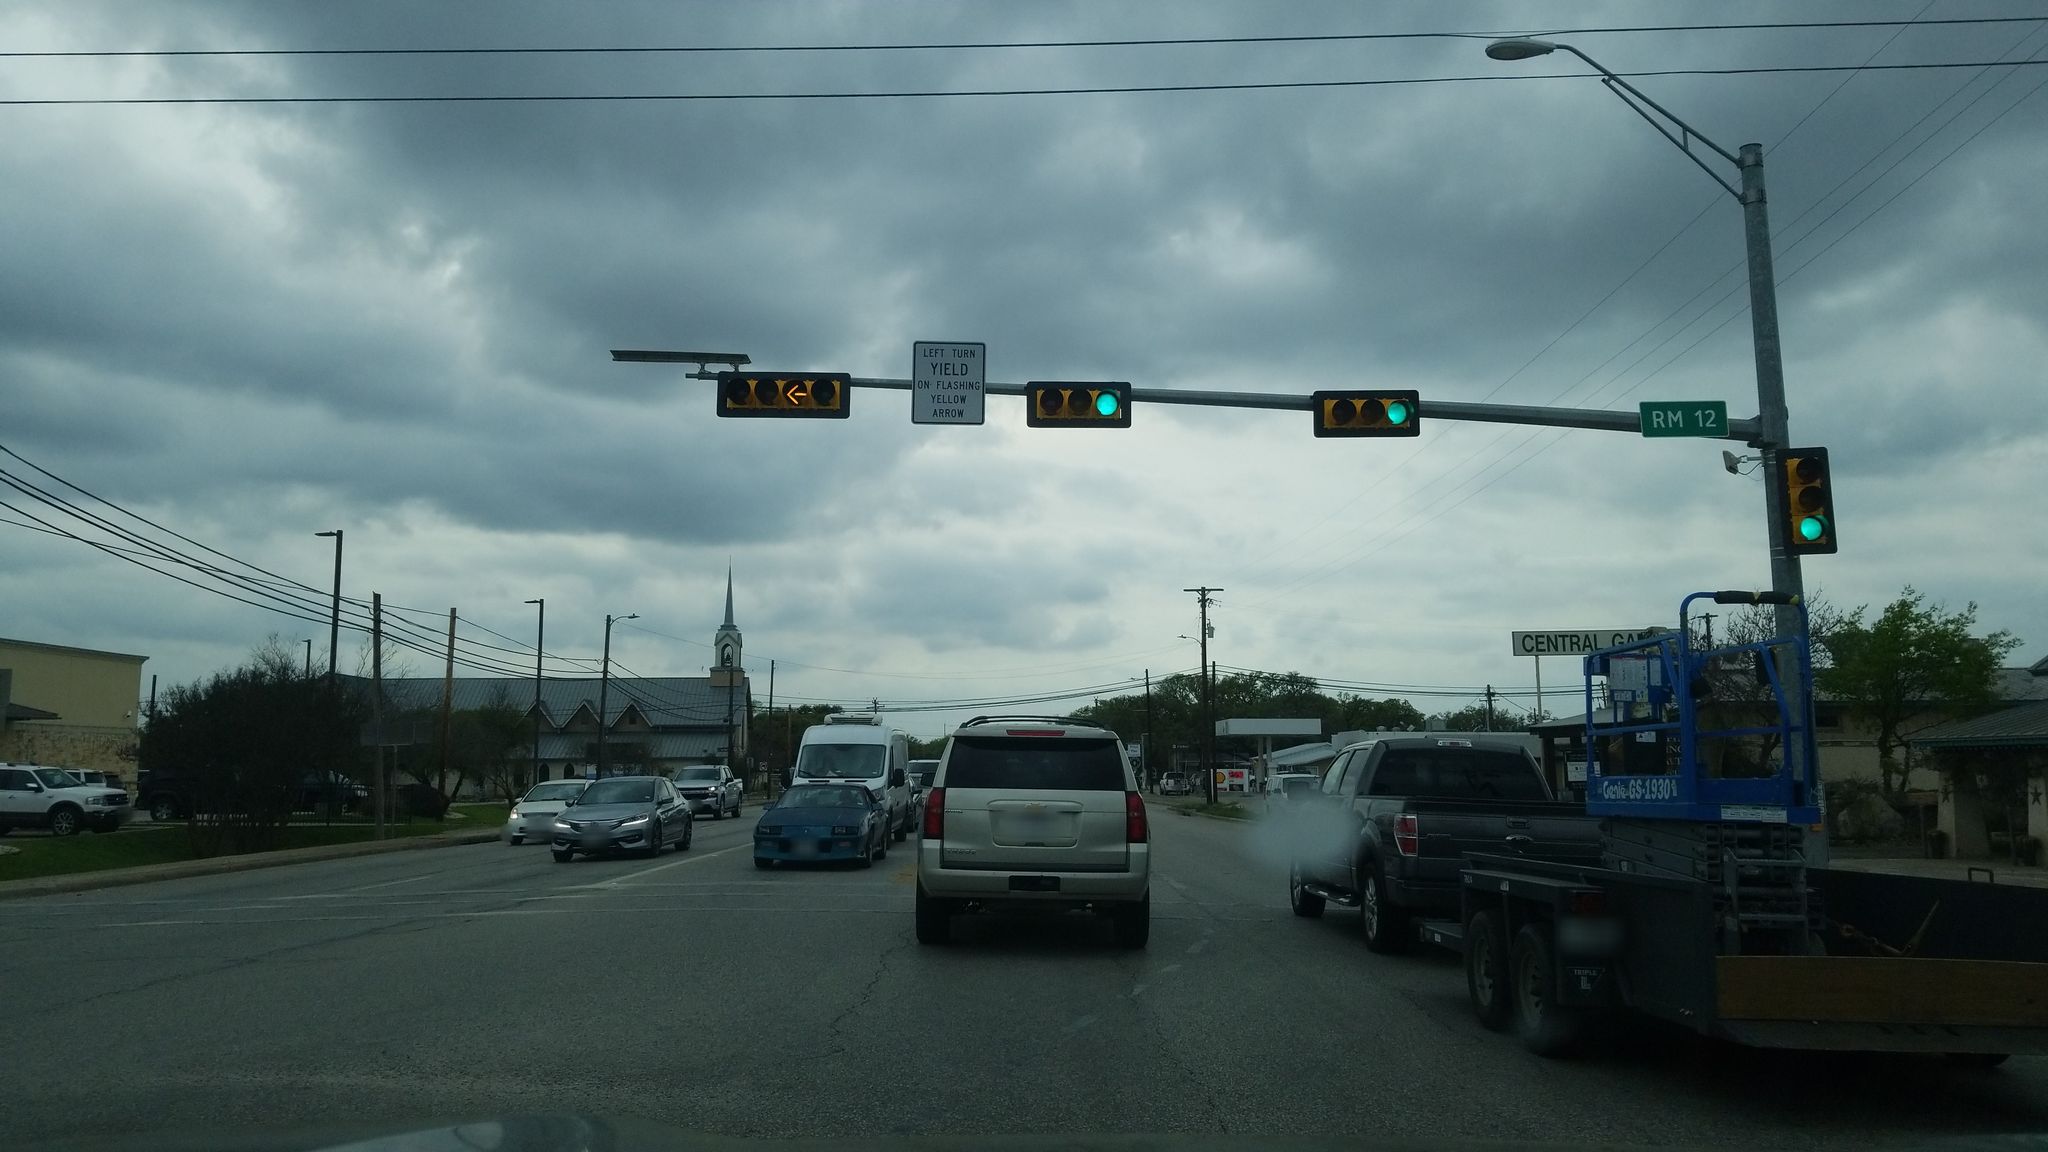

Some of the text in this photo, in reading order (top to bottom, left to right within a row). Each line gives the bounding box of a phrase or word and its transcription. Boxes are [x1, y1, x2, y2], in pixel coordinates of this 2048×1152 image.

[923, 348, 976, 359] LEFT TURN
[931, 362, 969, 376] YIELD
[917, 380, 980, 391] ON FLASHING
[931, 394, 967, 404] YELLOW
[932, 408, 965, 418] ARROW
[1652, 409, 1717, 429] RM 12
[1521, 633, 1603, 653] CENTRAL
[1603, 780, 1627, 801] Genie
